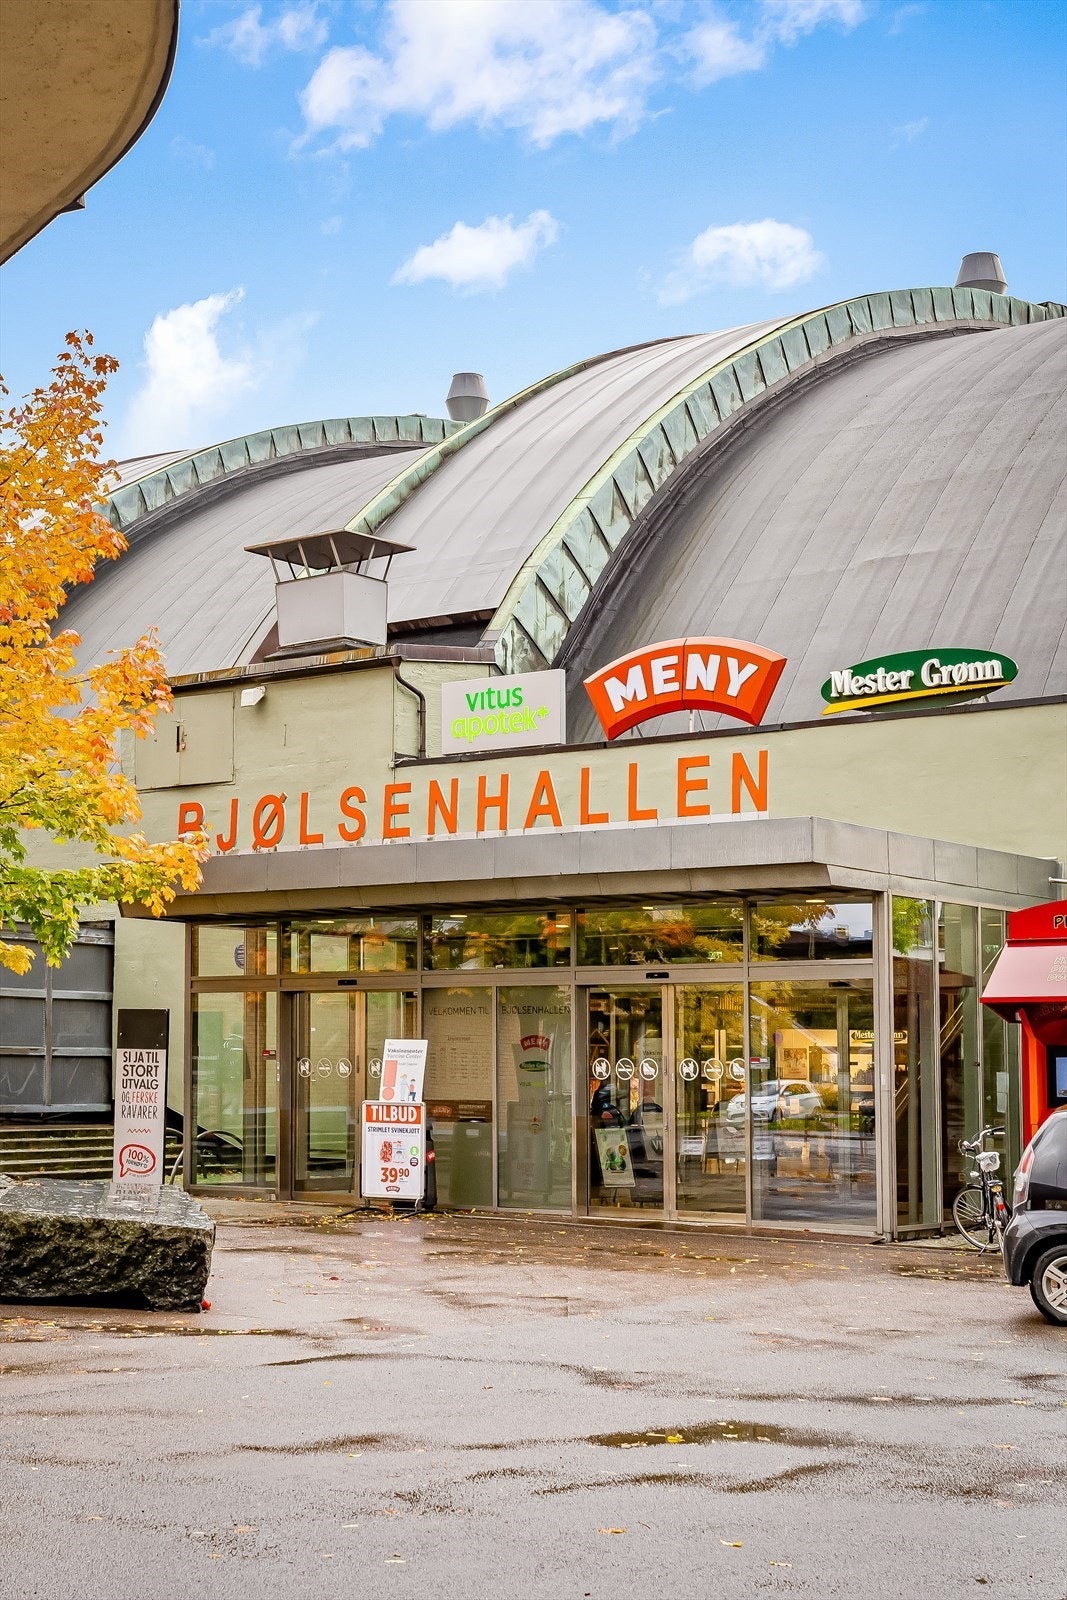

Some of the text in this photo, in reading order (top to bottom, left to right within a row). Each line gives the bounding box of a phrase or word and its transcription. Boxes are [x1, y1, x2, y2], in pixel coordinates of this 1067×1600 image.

[603, 653, 759, 713] MENY
[829, 658, 1004, 698] Mester Grønn
[465, 687, 524, 712] vitus
[178, 750, 769, 851] BJØLSENHALLEN
[428, 1005, 571, 1016] VELKOMMEN TIL BJØLSENHALLEN
[123, 1051, 159, 1063] SI JA TIL
[122, 1064, 159, 1077] STORT
[122, 1078, 159, 1090] UTVALG
[131, 1091, 158, 1103] FERSKE
[370, 1105, 418, 1122] TILBUD
[128, 1149, 149, 1164] 100%
[380, 1167, 410, 1183] 39 90
